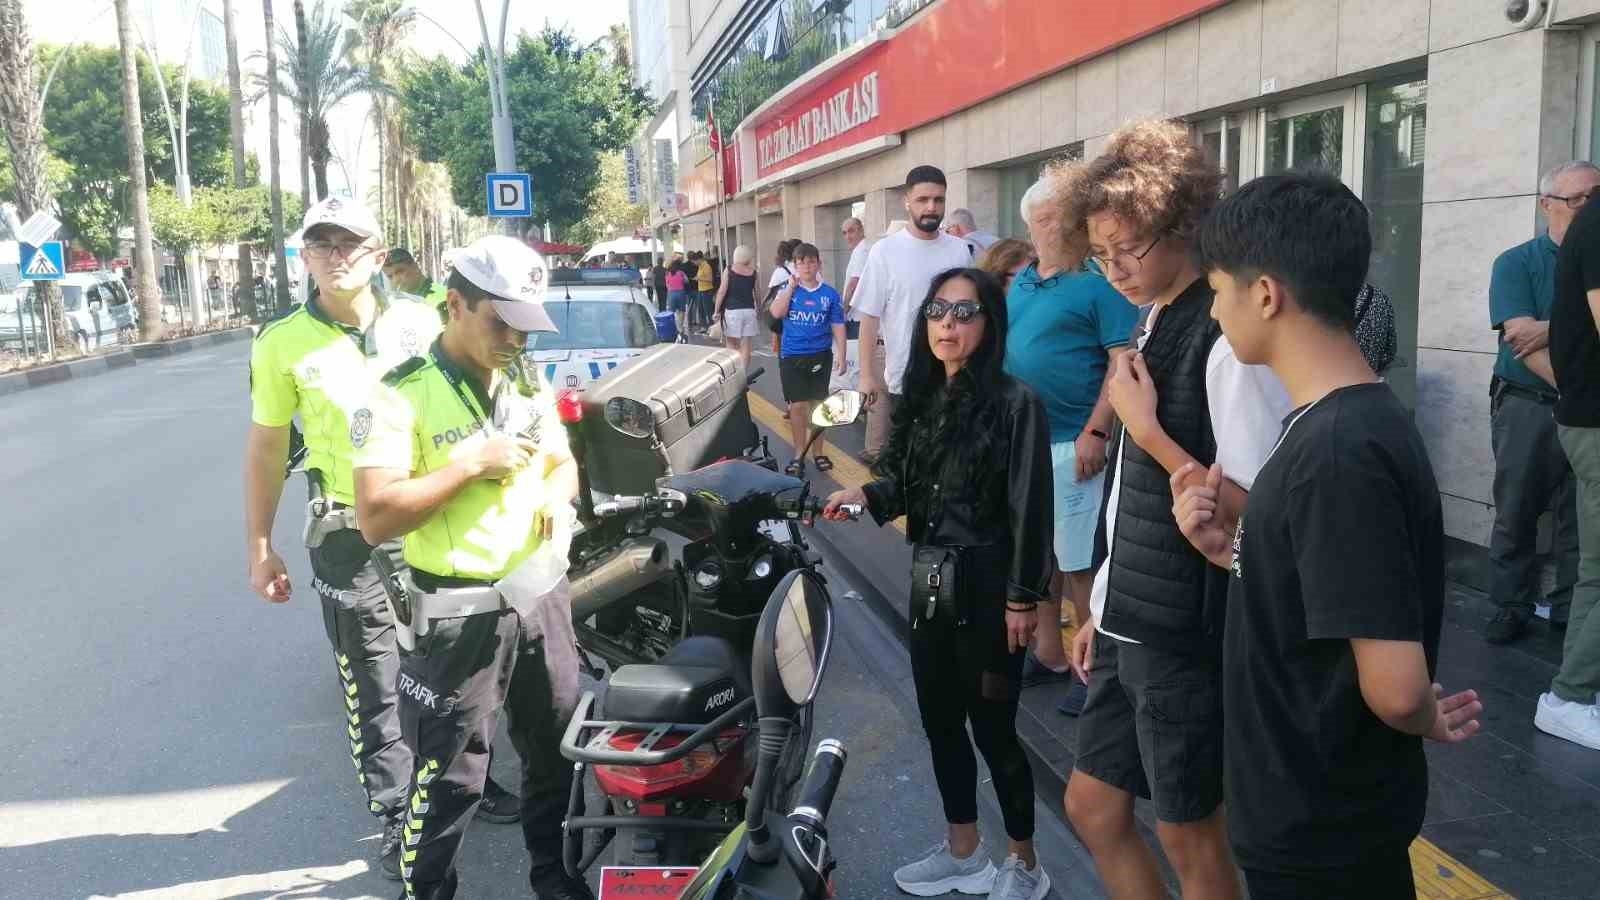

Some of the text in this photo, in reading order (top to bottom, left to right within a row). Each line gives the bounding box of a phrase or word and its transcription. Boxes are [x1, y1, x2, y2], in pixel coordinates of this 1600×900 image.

[812, 72, 880, 145] BANKASI
[500, 183, 519, 206] D
[790, 311, 826, 323] SAVVY
[704, 687, 735, 712] ARORA
